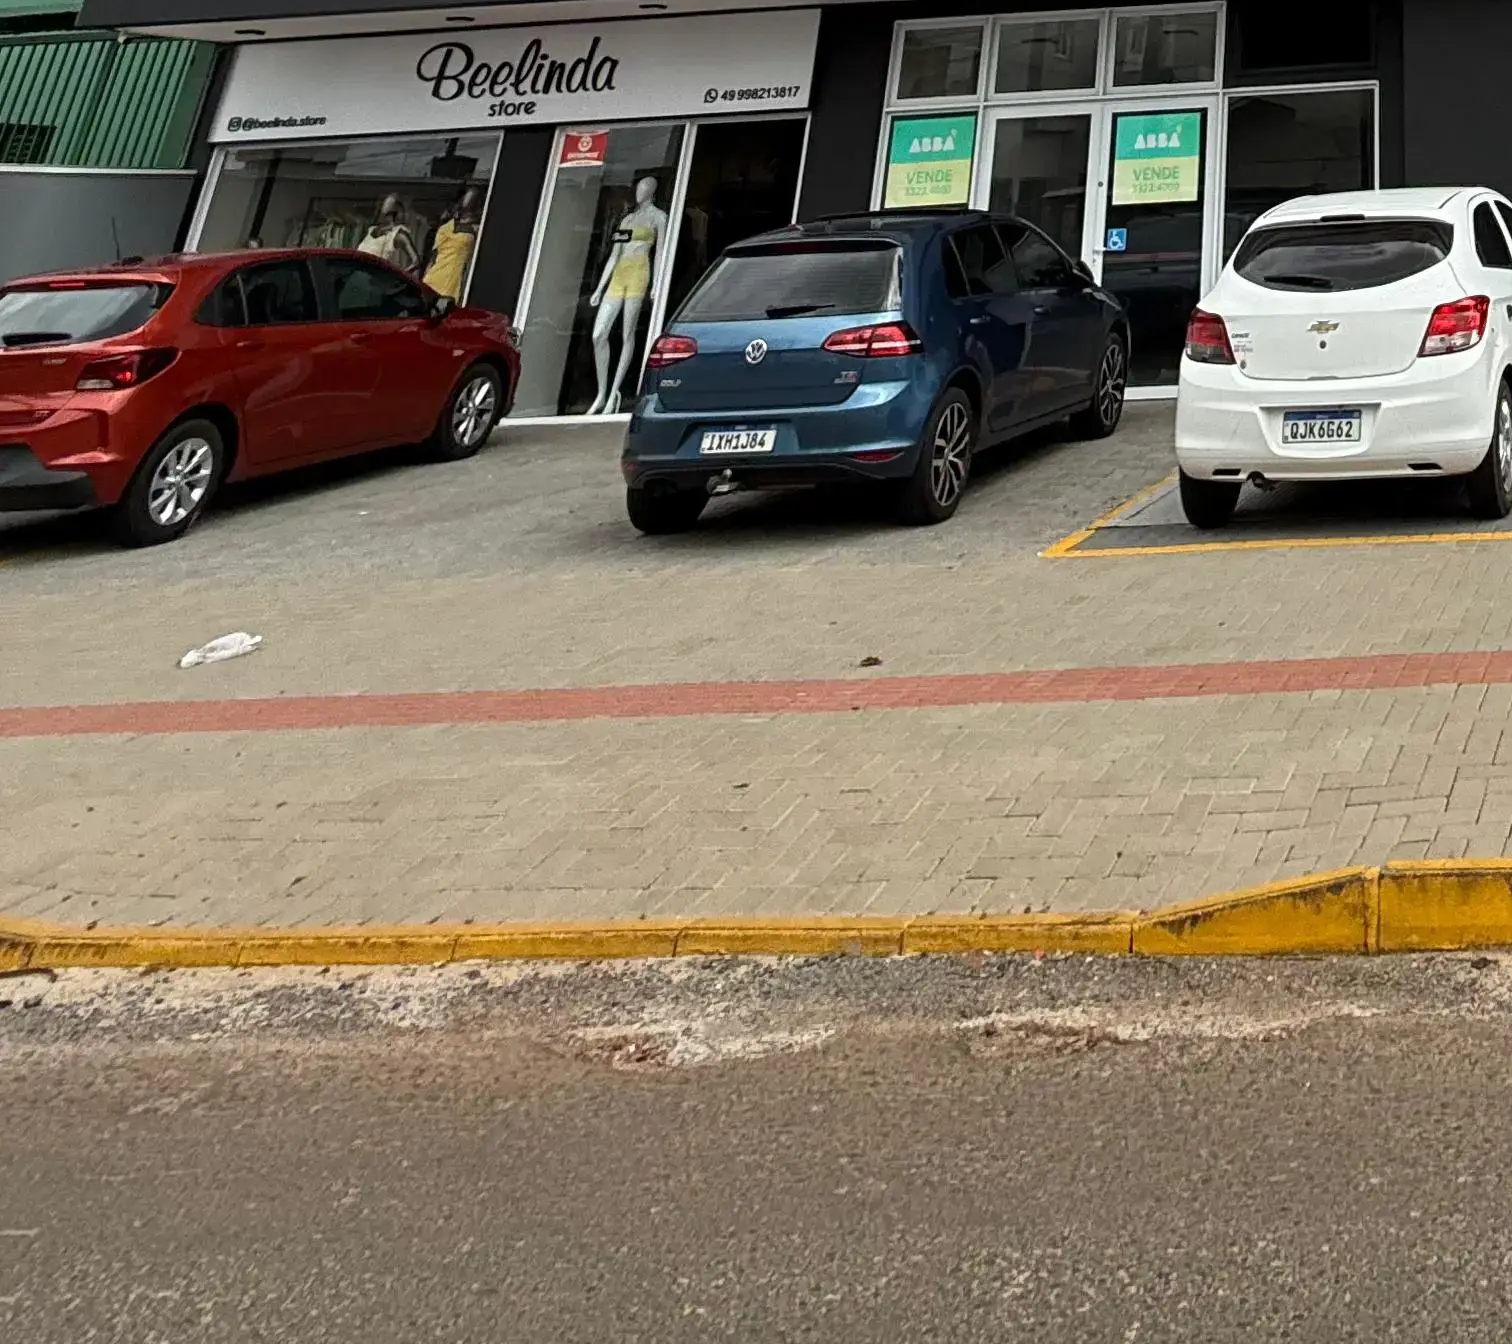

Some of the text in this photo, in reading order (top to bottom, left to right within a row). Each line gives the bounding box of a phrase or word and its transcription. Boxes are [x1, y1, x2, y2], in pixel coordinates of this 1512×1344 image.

[416, 36, 619, 101] Beelinda
[721, 85, 800, 101] 49 998213817
[488, 101, 536, 117] store
[906, 169, 953, 184] VENDE
[1133, 166, 1180, 181] VENDE
[1290, 421, 1353, 439] QJK6G62
[706, 432, 767, 450] IXH1J84
